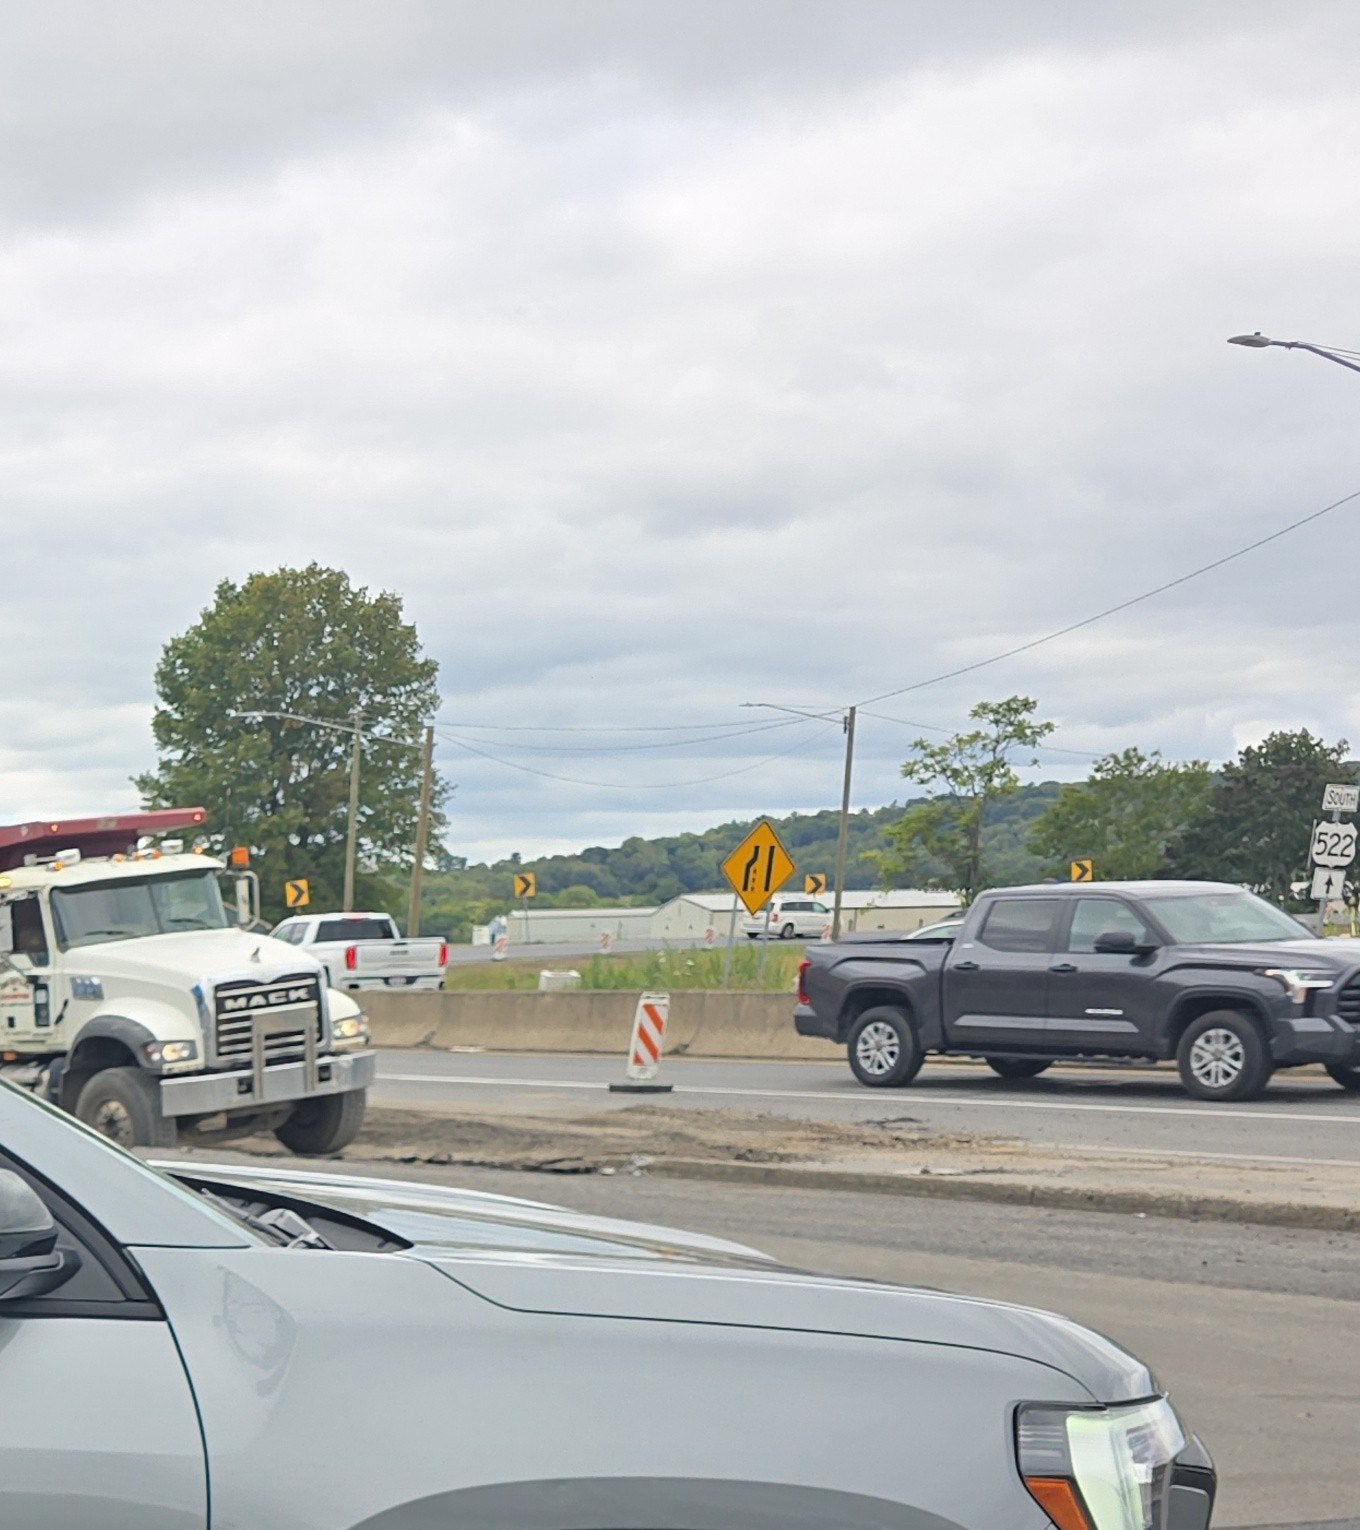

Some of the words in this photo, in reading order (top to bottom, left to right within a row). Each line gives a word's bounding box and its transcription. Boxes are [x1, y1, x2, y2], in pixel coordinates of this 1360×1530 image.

[1327, 789, 1356, 806] SOUTH
[1315, 832, 1354, 858] 522
[224, 987, 310, 1011] MACK
